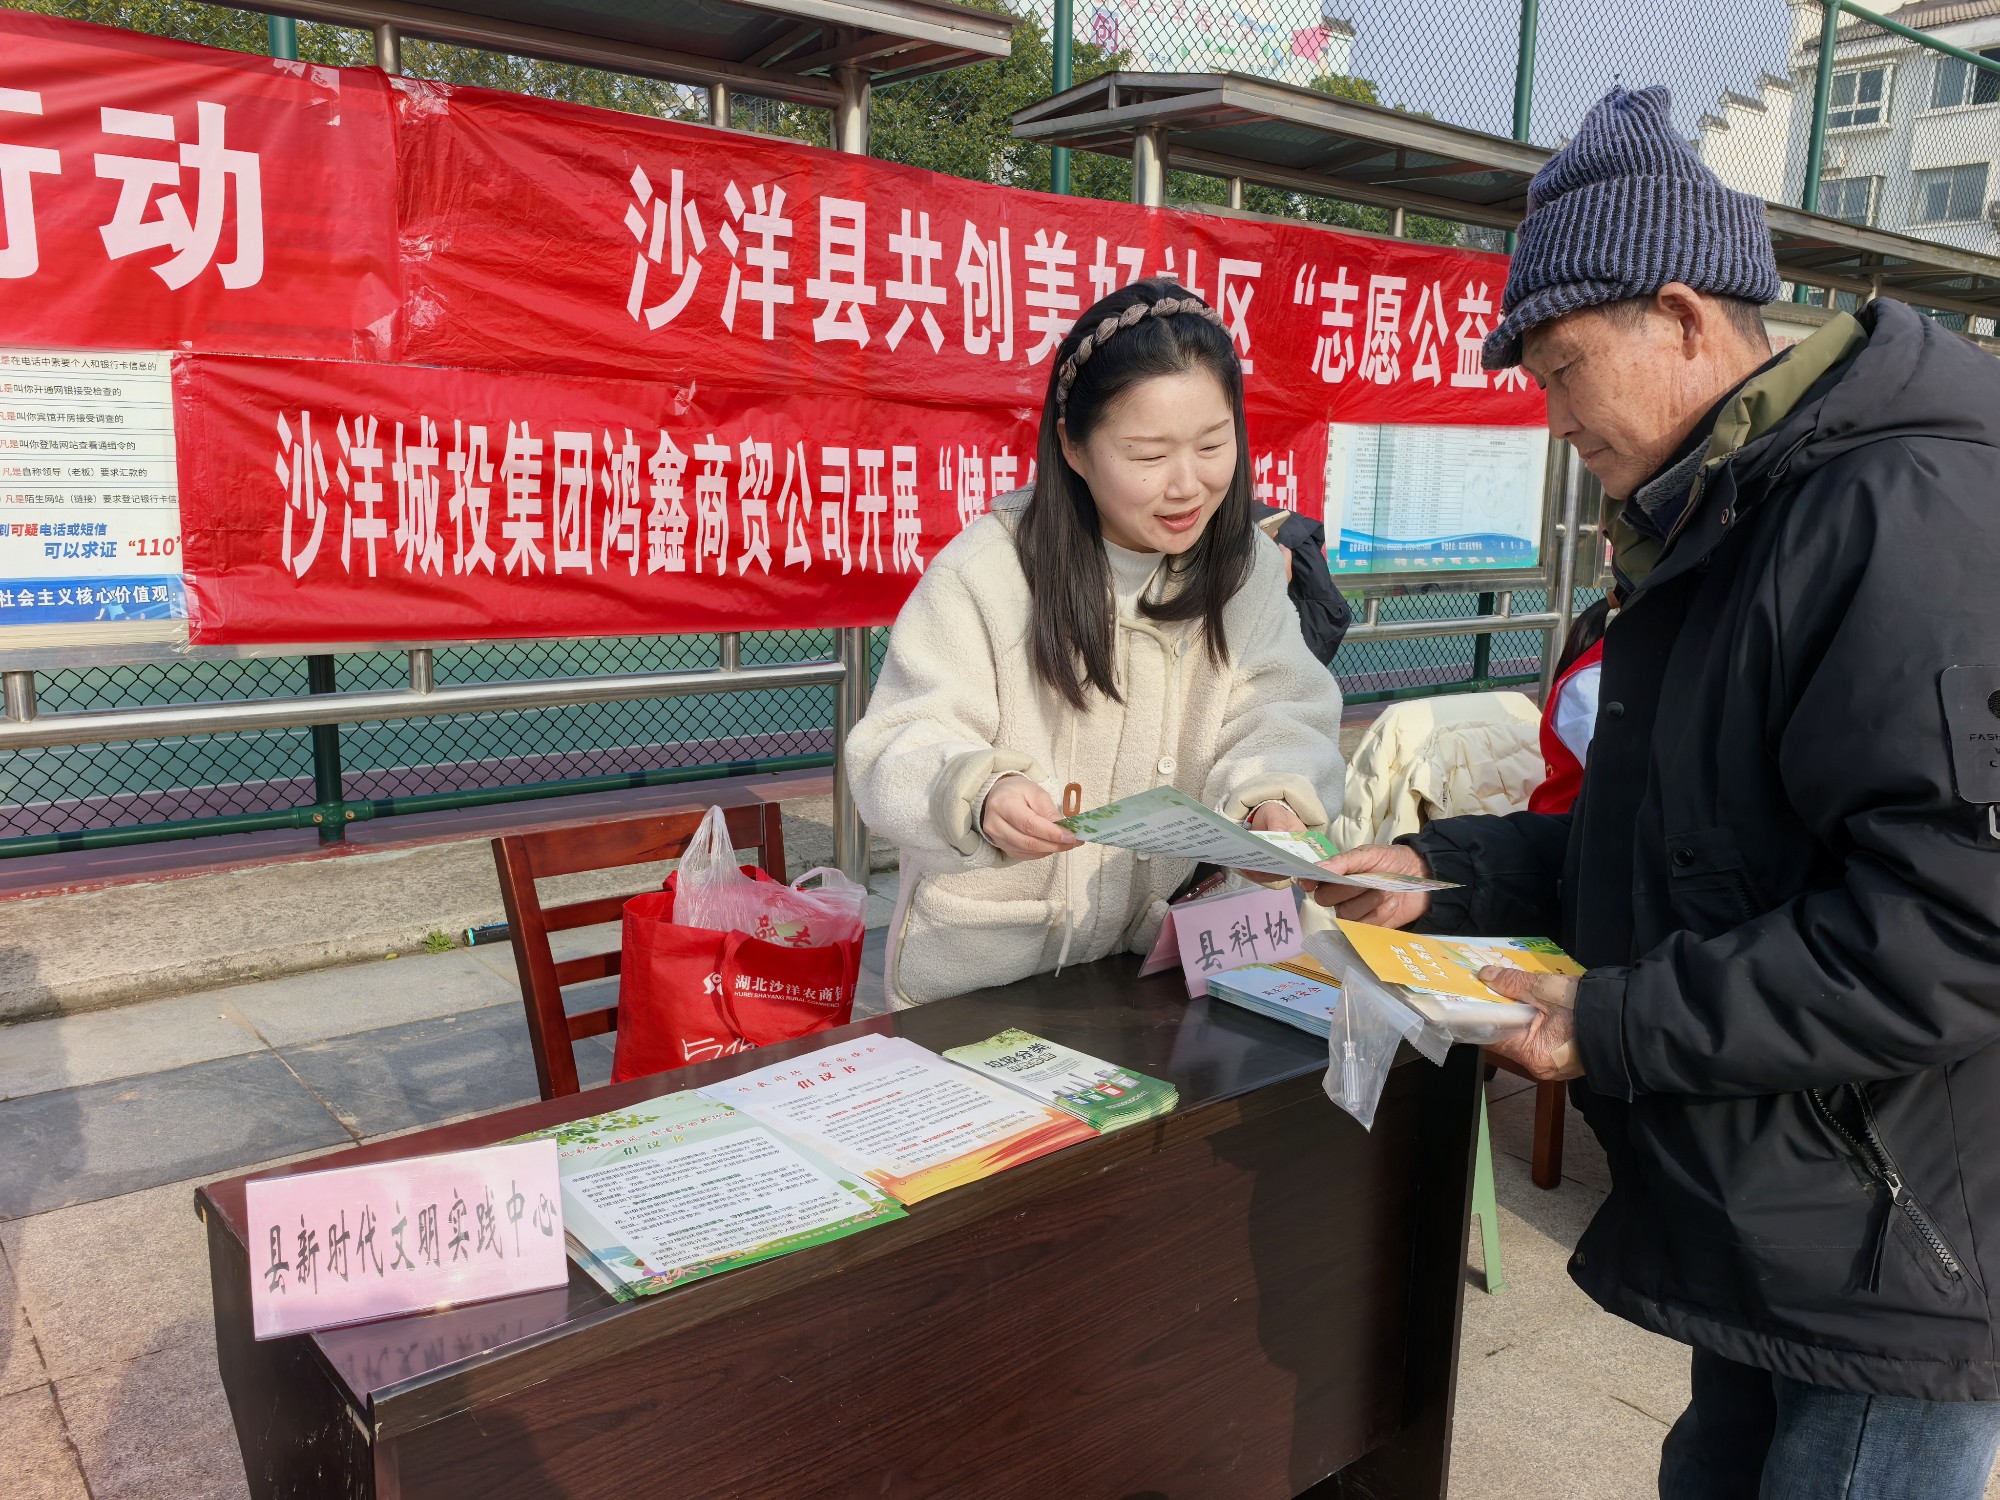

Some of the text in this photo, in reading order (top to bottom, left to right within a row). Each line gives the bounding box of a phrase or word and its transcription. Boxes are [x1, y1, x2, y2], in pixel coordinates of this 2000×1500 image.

[624, 164, 1528, 393] 沙洋县共创美区“志愿公益
[5, 494, 180, 505] 凡是陌生网站（链接）要求登记银行卡信
[275, 410, 1037, 580] 沙洋城投集团鸿鑫商贸公司开展“健
[44, 541, 118, 560] 可以求证
[1194, 910, 1295, 972] 县科协
[264, 1179, 557, 1295] 县新时代文明实践中心
